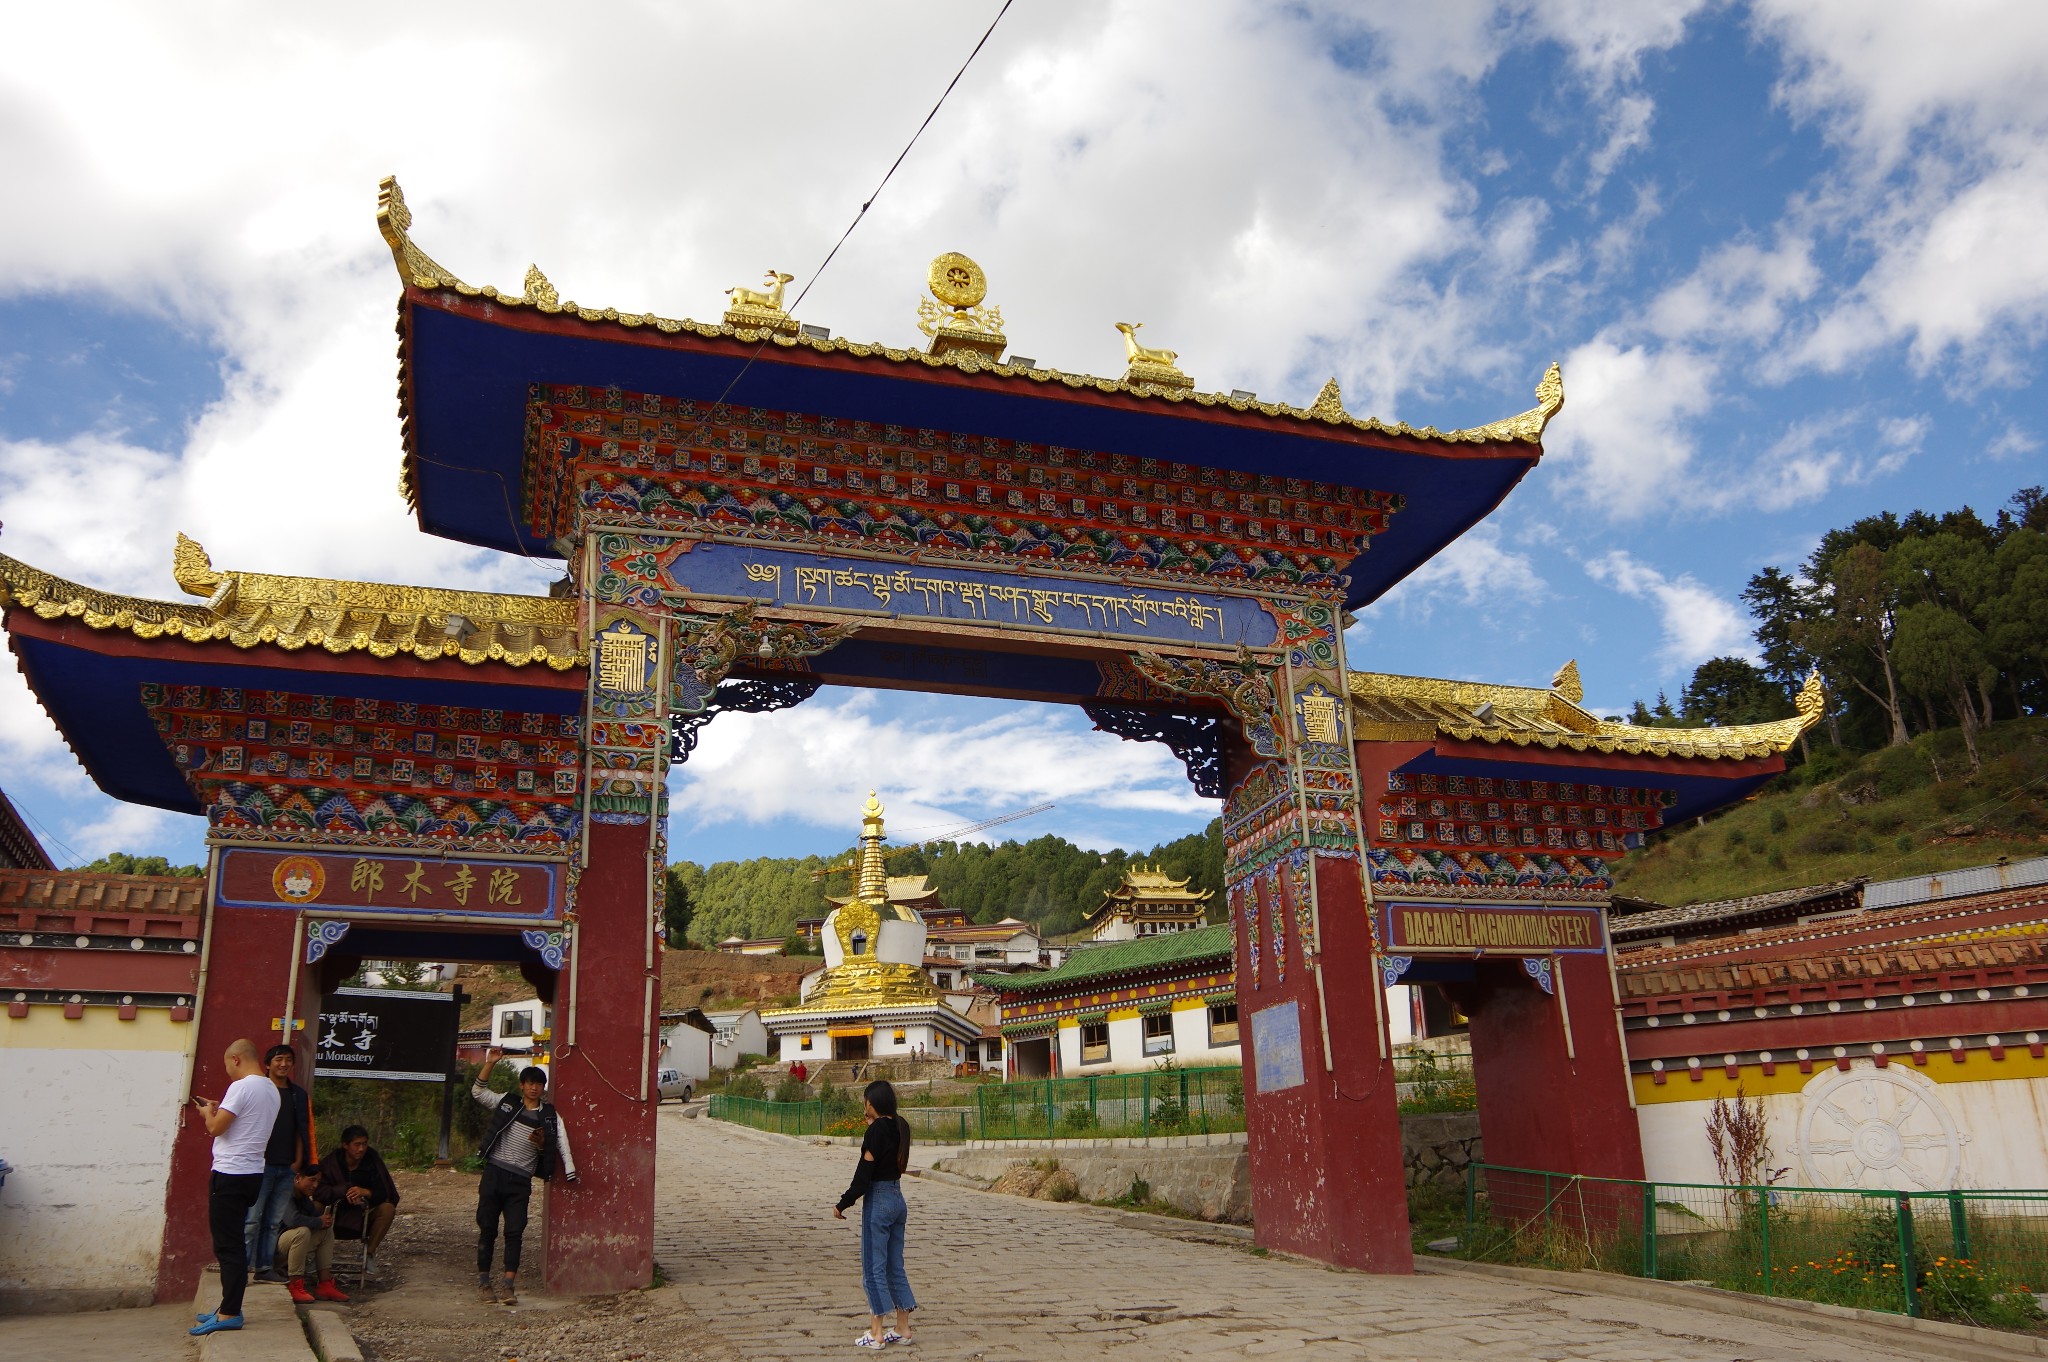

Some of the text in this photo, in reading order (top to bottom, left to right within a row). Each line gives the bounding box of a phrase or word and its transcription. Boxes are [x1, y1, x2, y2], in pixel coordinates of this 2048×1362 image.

[351, 858, 522, 906] 郎木寺院
[326, 1050, 375, 1065] Monastery
